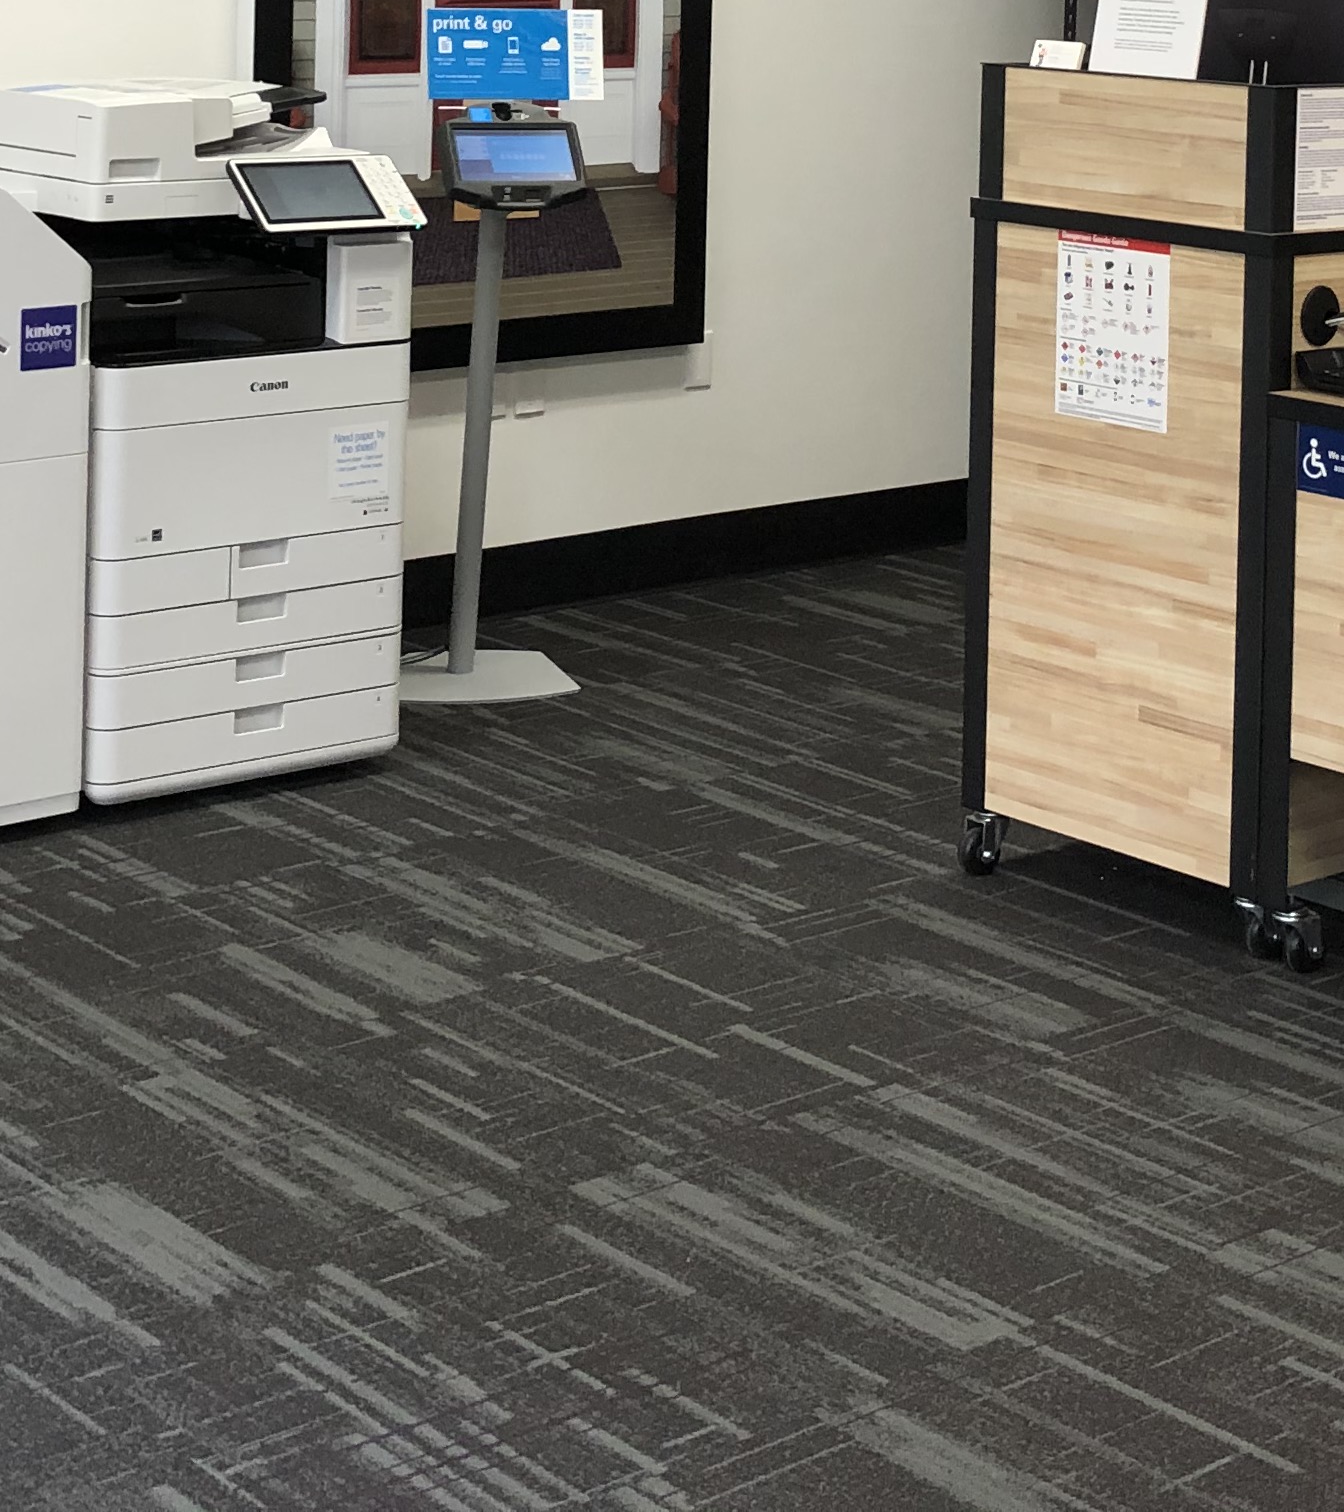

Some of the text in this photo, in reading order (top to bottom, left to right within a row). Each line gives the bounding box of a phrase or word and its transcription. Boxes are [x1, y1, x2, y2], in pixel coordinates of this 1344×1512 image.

[432, 15, 513, 34] print & go
[25, 323, 73, 340] kinko's
[24, 337, 73, 354] copying
[249, 379, 289, 393] Canon
[1327, 450, 1340, 461] We
